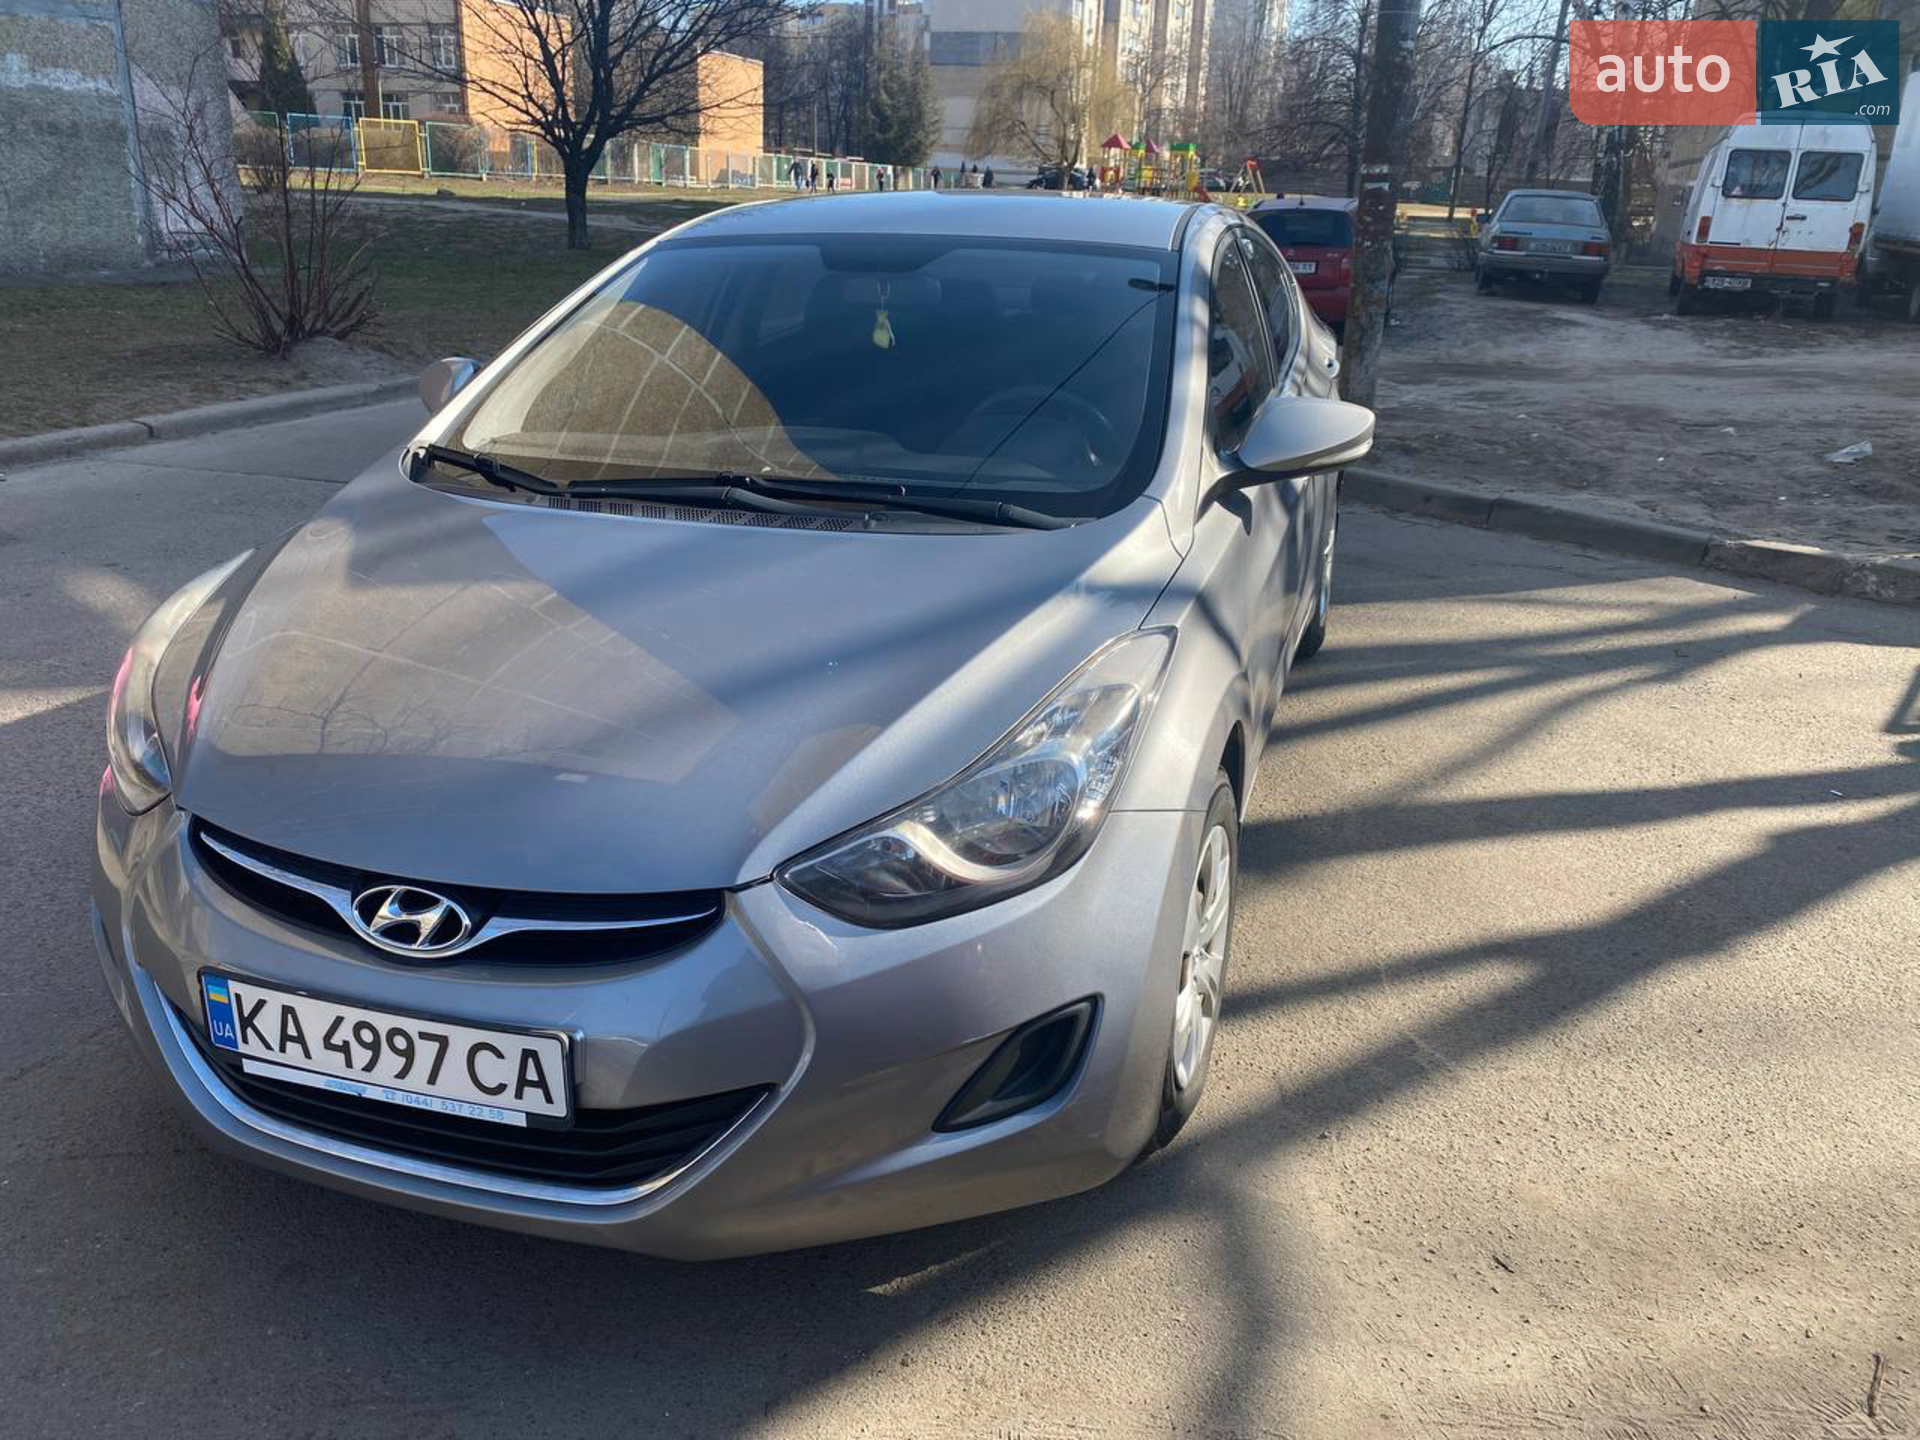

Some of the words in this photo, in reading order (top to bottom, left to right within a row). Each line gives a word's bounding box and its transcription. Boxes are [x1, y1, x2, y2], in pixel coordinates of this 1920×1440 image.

[213, 1019, 235, 1040] UA
[234, 992, 313, 1060] KA
[322, 1015, 449, 1086] 4997
[466, 1042, 554, 1105] CA
